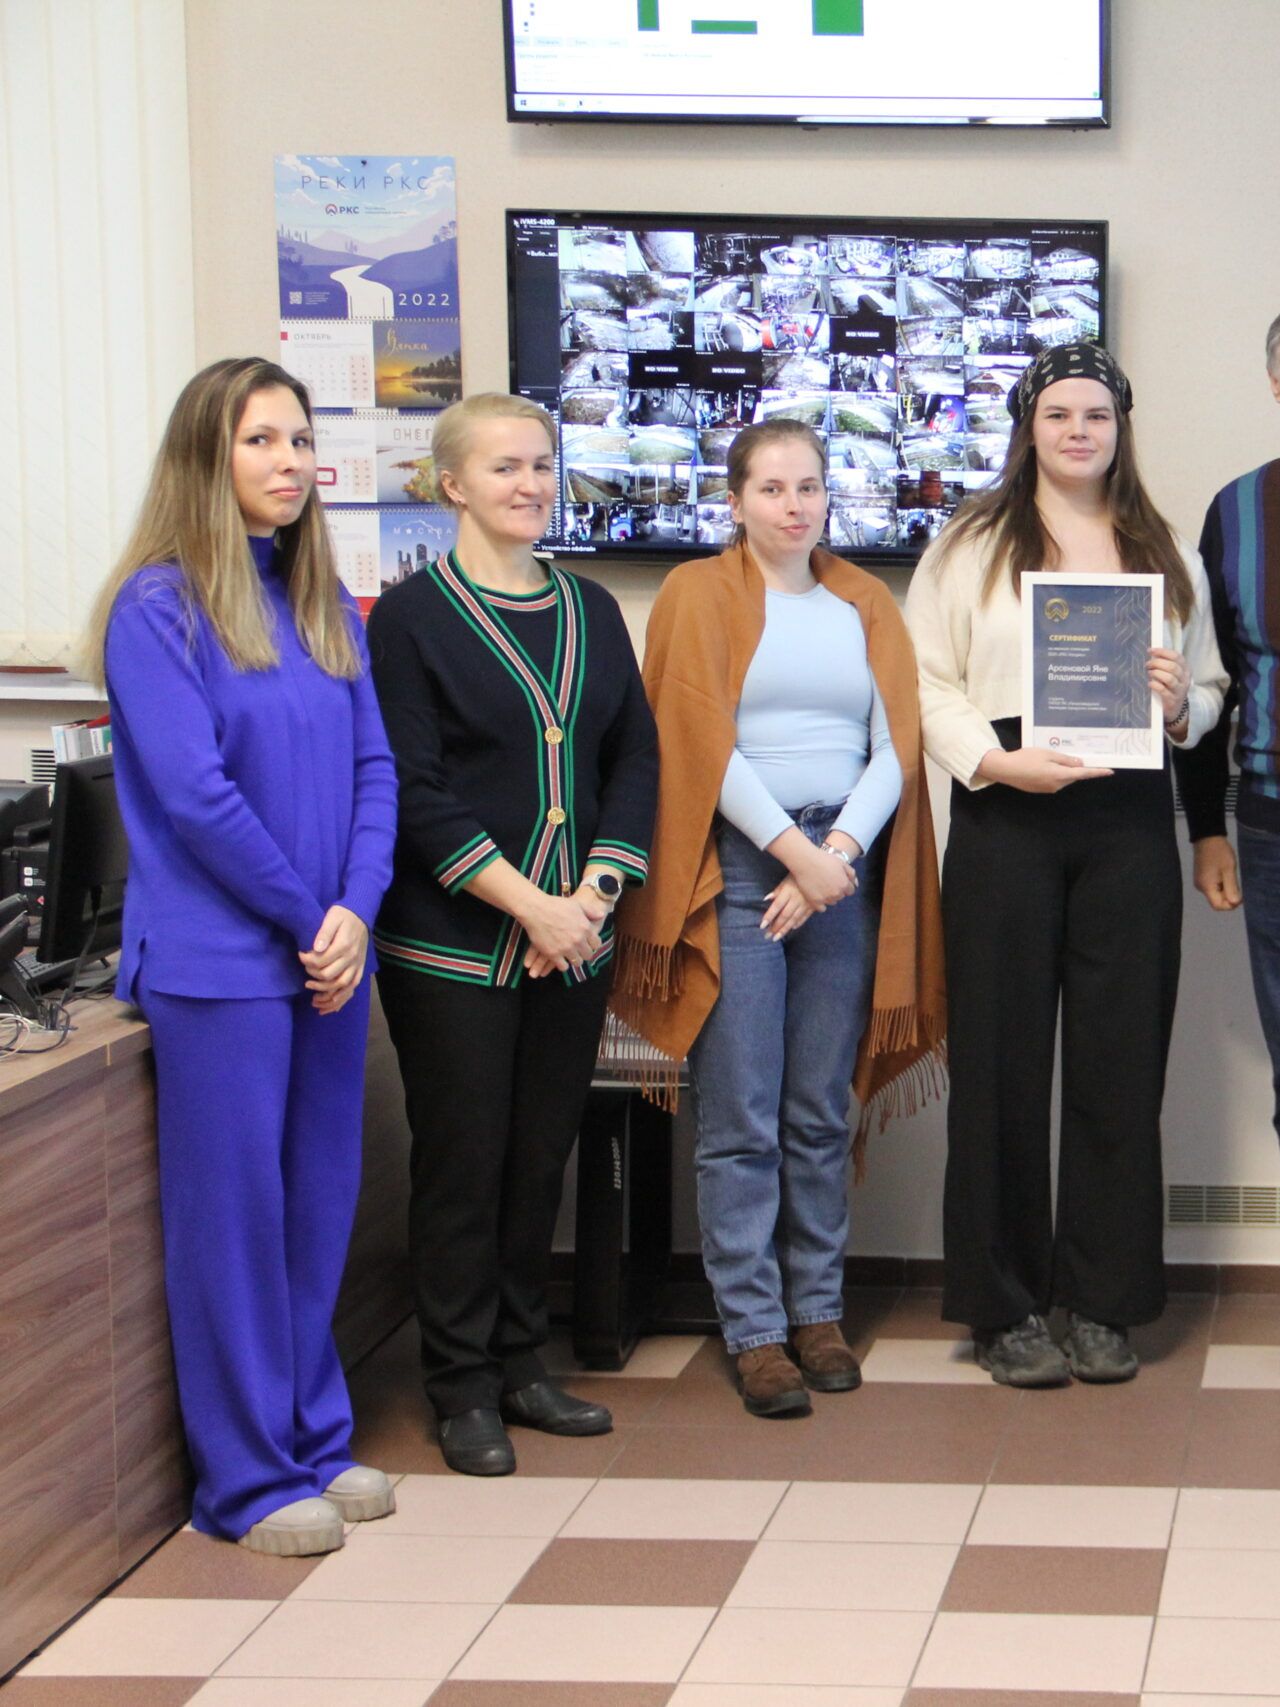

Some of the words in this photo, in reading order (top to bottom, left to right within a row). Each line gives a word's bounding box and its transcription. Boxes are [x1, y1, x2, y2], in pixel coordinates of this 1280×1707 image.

[301, 175, 367, 190] РЕКИ
[383, 175, 430, 190] РКС
[339, 206, 360, 215] РКС
[399, 293, 450, 306] 2022
[294, 333, 331, 341] ОКТЯБРЬ
[393, 428, 433, 440] ОНЕГ
[1082, 605, 1103, 614] 2022
[1049, 634, 1098, 643] СЕРТИФИКАТ
[1092, 664, 1109, 673] Яне
[1048, 673, 1108, 683] Владимировне
